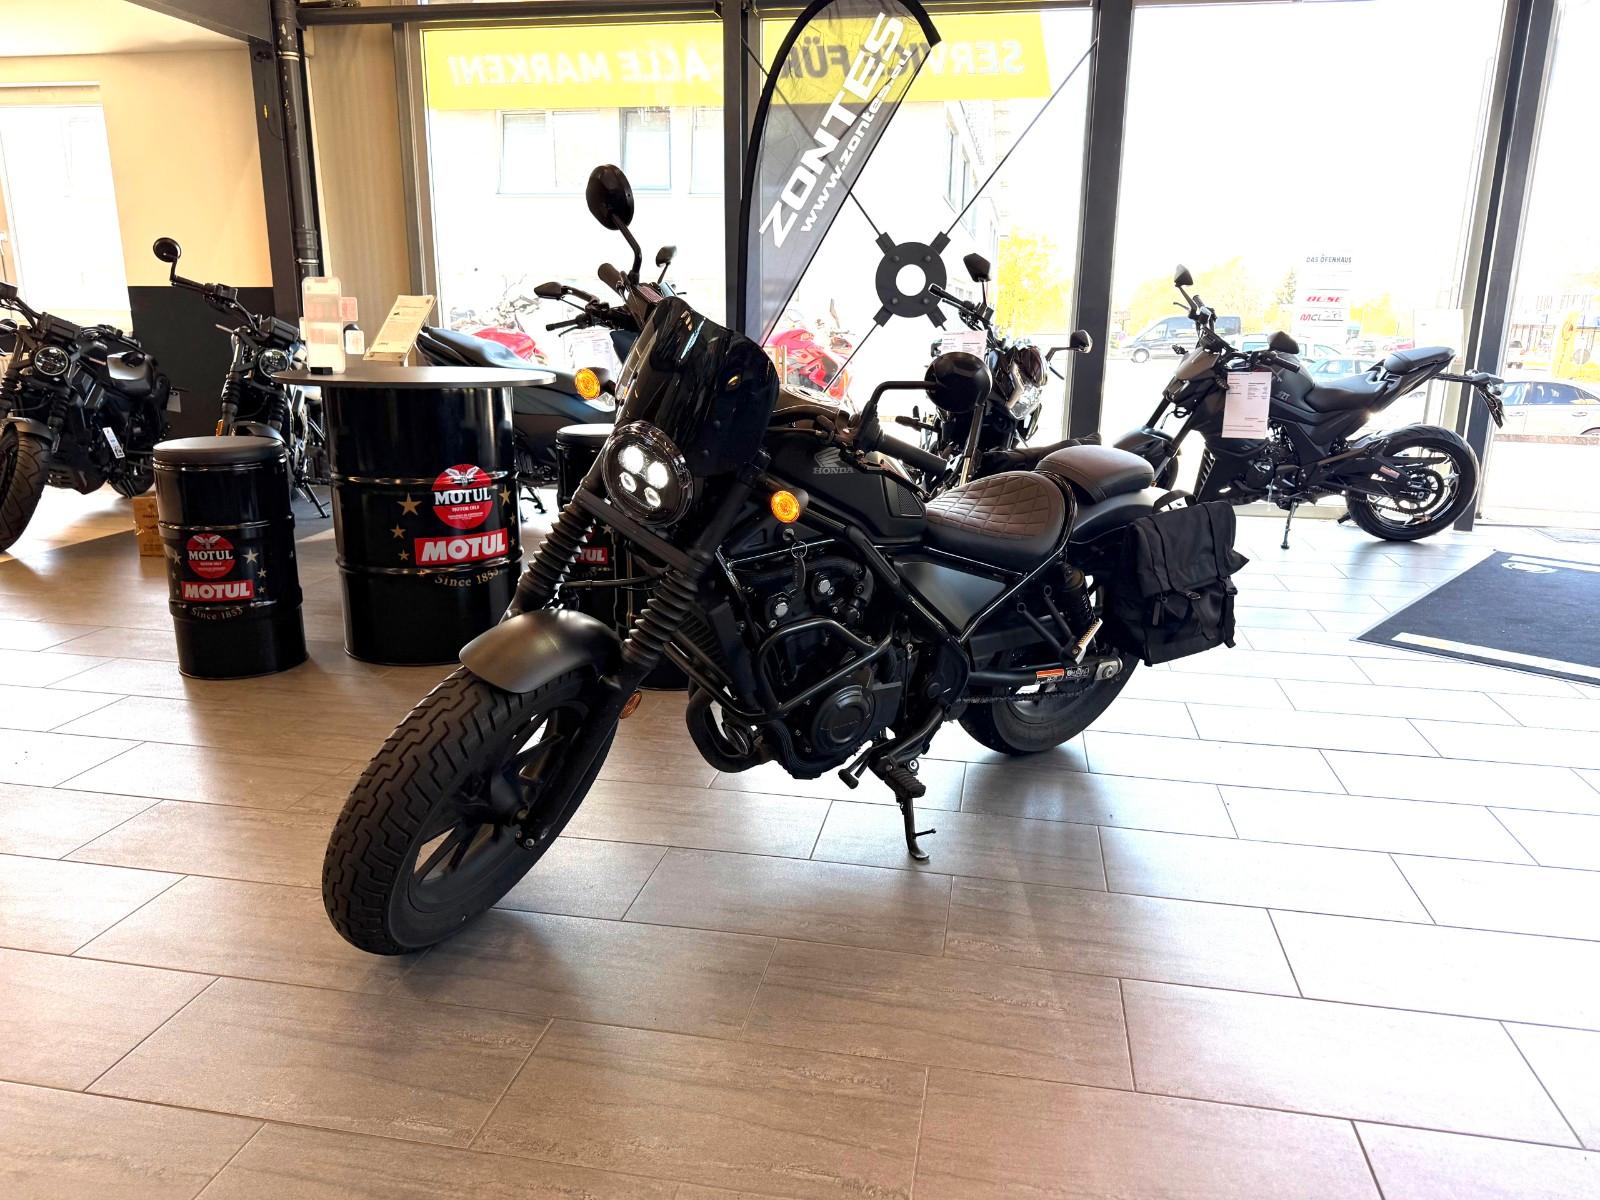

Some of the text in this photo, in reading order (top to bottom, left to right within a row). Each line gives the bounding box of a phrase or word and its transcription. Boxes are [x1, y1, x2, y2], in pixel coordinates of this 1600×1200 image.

[759, 12, 904, 248] ZONTES
[801, 48, 913, 232] www.zontes.eu
[813, 467, 855, 475] HONDA
[434, 487, 492, 505] MOTUL
[188, 550, 233, 561] MOTUL
[421, 532, 506, 562] MOTUL
[434, 574, 472, 588] Since
[184, 582, 251, 599] MOTUL
[191, 607, 217, 620] Since
